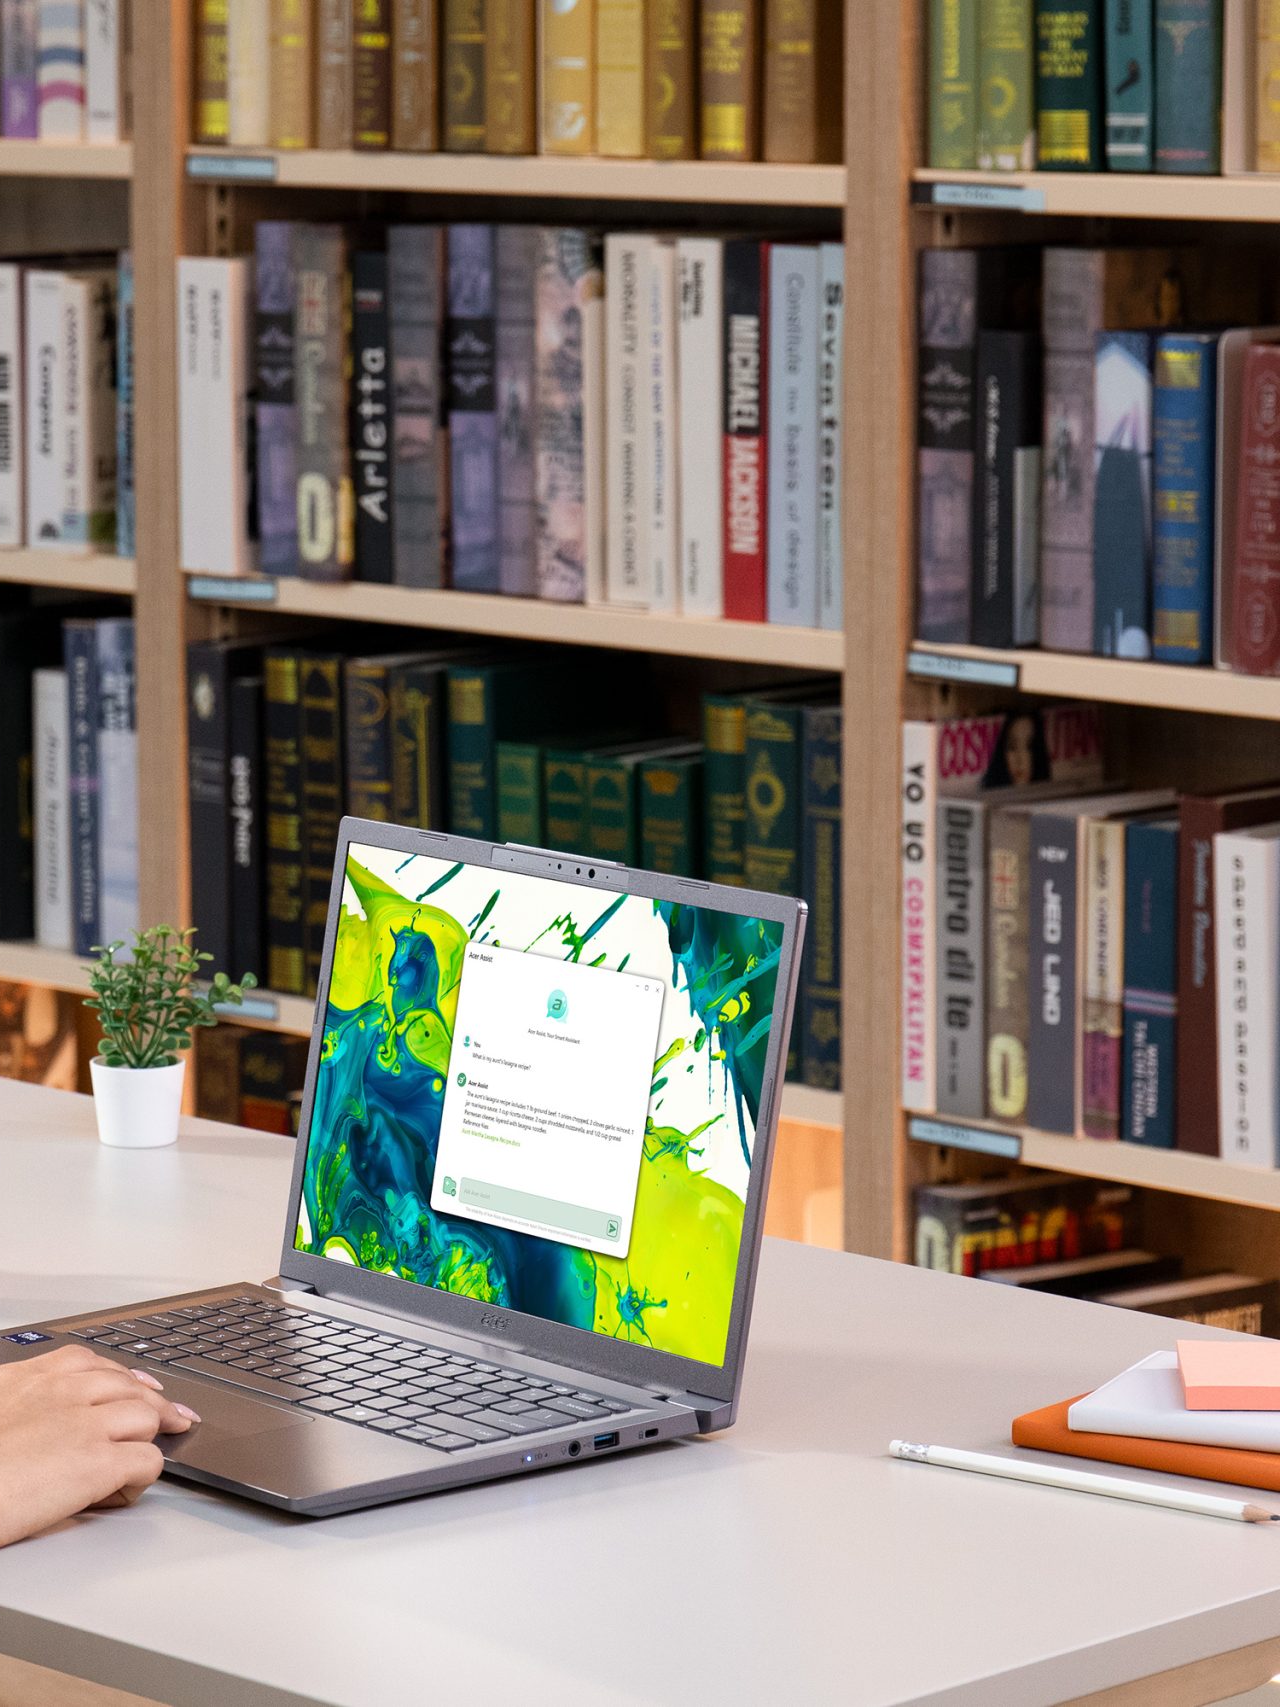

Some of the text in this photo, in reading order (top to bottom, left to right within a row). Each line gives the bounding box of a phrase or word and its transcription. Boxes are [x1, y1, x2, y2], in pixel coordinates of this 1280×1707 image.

[356, 346, 388, 522] Arletta
[729, 315, 760, 556] MICHAEL JACKSON
[821, 282, 844, 512] Seventeen
[945, 806, 975, 935] Dentro
[1042, 879, 1062, 944] JED
[469, 951, 493, 963] Acer Assist
[945, 948, 976, 982] di
[945, 995, 975, 1030] te
